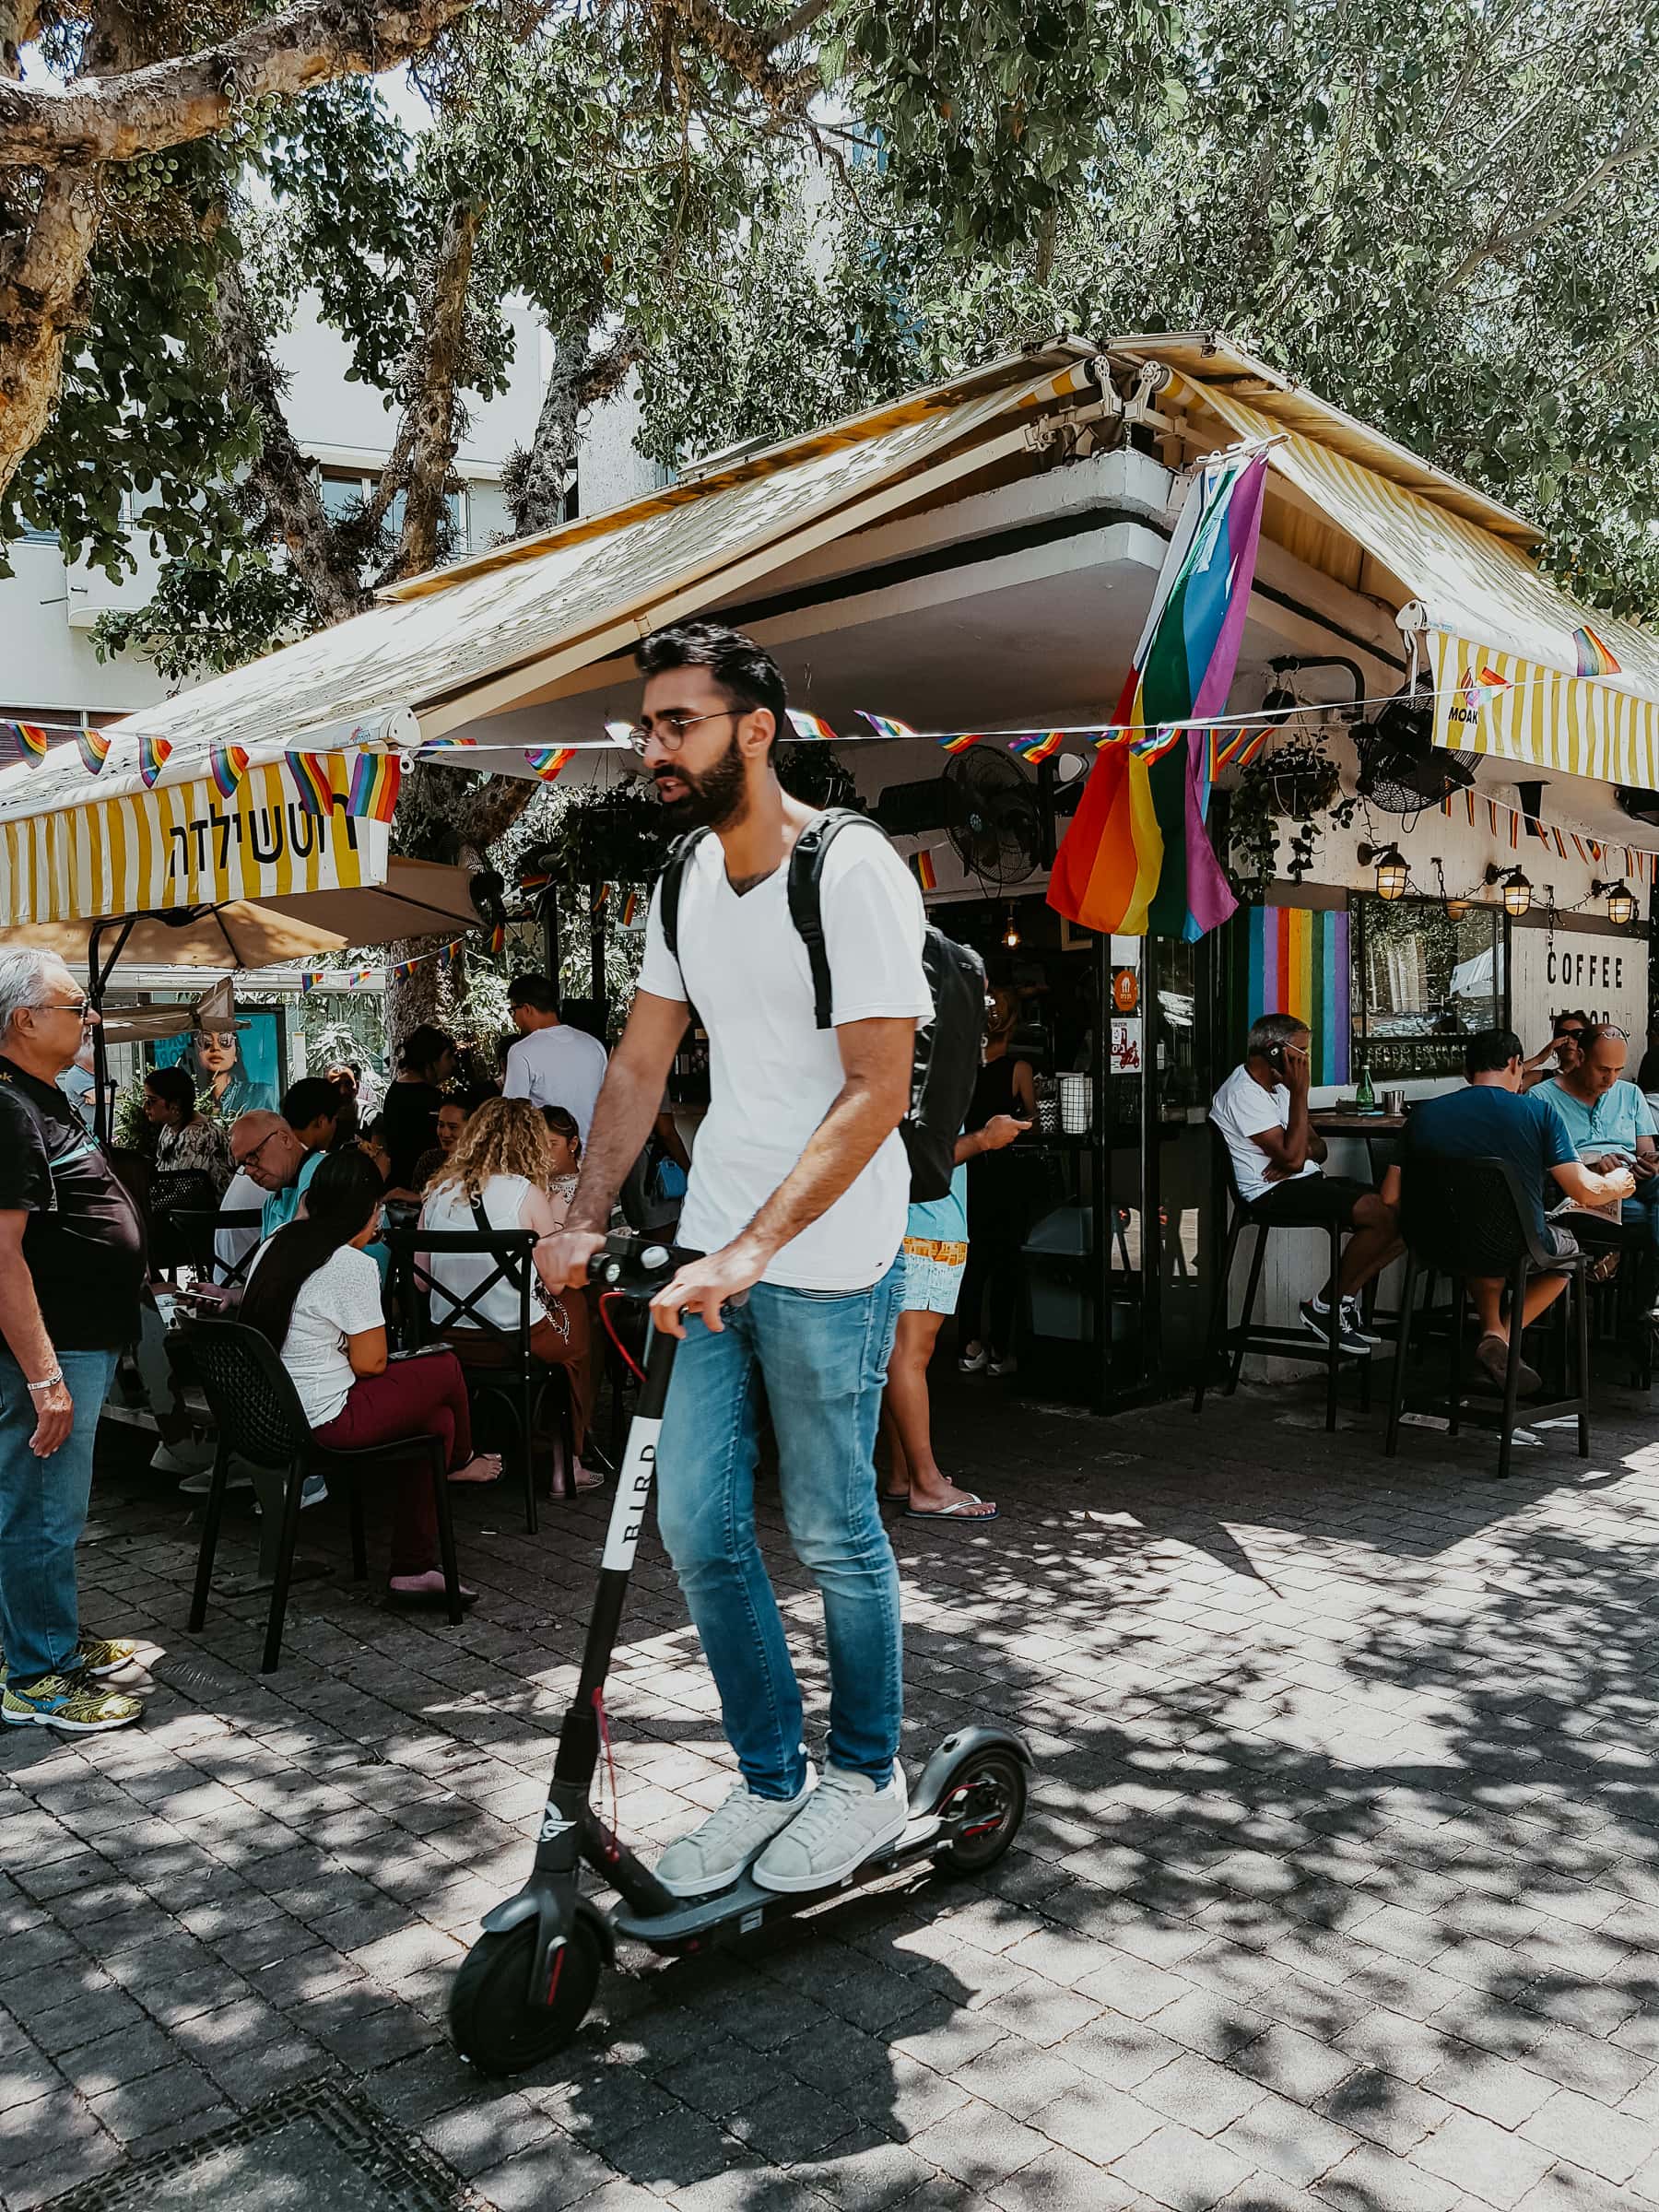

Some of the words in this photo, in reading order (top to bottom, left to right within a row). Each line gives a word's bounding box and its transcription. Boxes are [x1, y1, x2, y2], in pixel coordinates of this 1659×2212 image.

[1448, 707, 1478, 724] MOAK
[1547, 951, 1622, 989] COFFEE
[621, 1444, 656, 1545] BIRD
